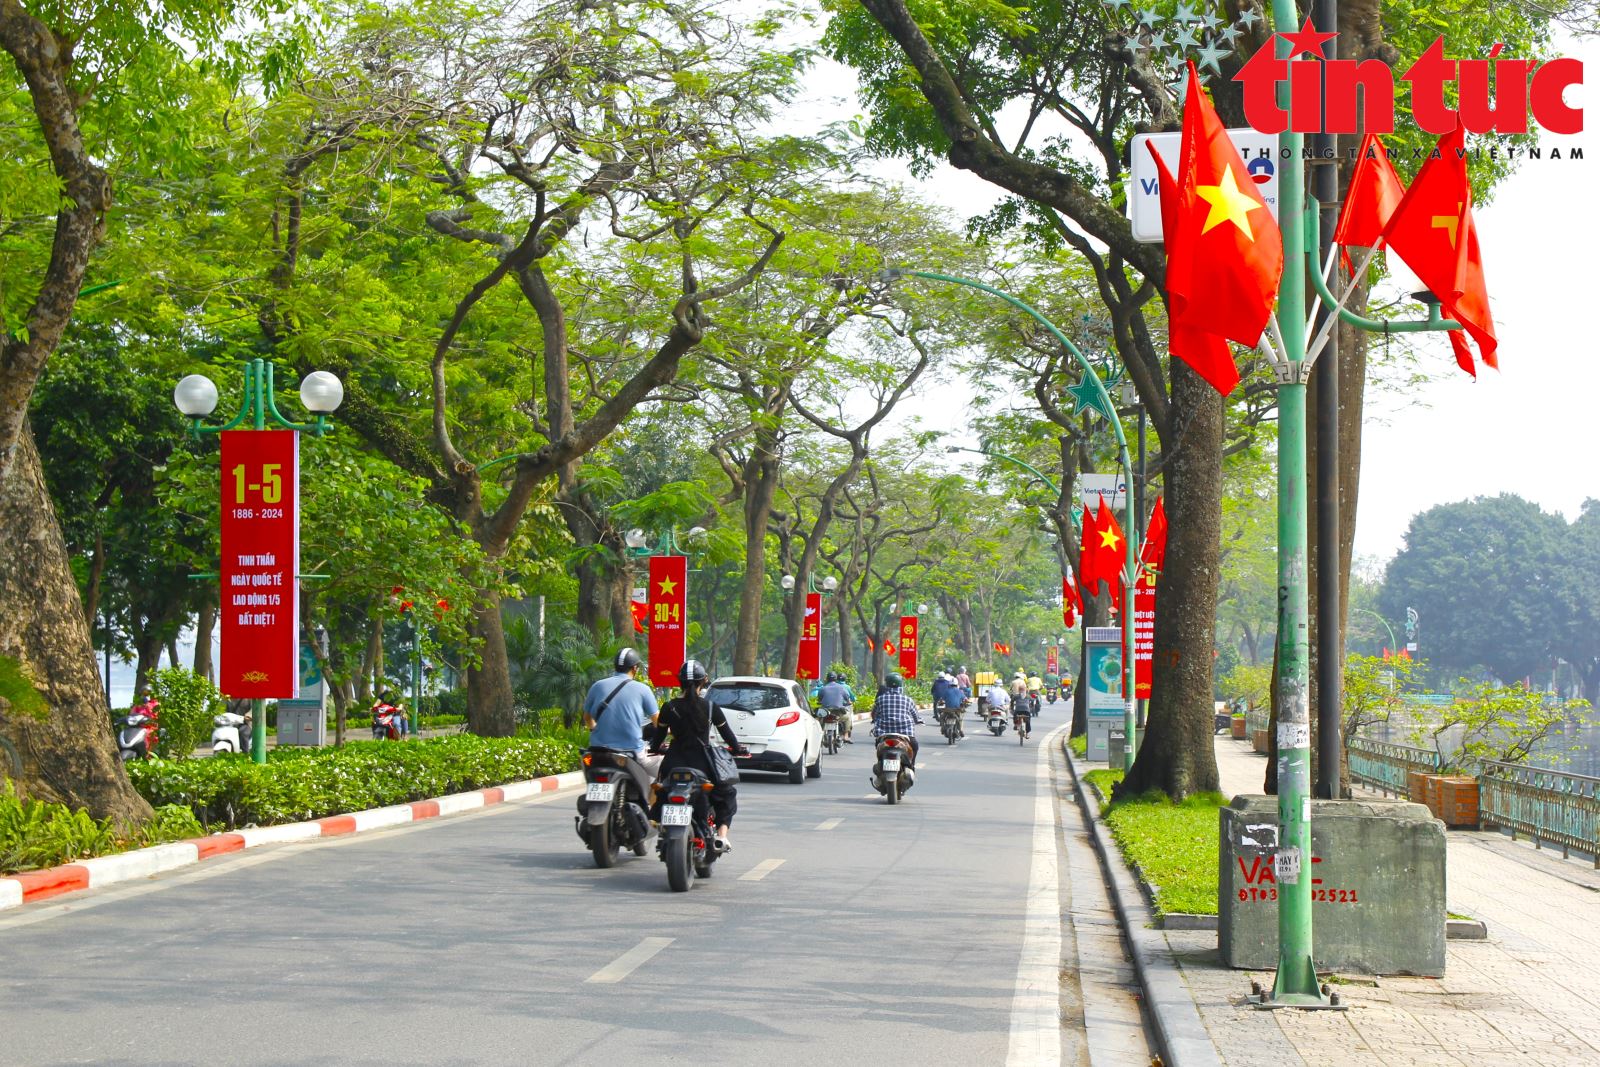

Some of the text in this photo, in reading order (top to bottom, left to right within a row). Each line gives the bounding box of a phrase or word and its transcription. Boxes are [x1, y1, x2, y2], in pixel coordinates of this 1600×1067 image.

[232, 463, 282, 504] 1-5
[232, 508, 253, 519] 1886
[261, 508, 283, 519] 2024
[238, 554, 255, 566] TINH
[231, 571, 283, 587] NGÀY QUỐC TẾ
[232, 594, 246, 606] LAO
[268, 594, 281, 606] 1/5
[238, 610, 253, 625] BẤT
[654, 603, 680, 623] 30-4
